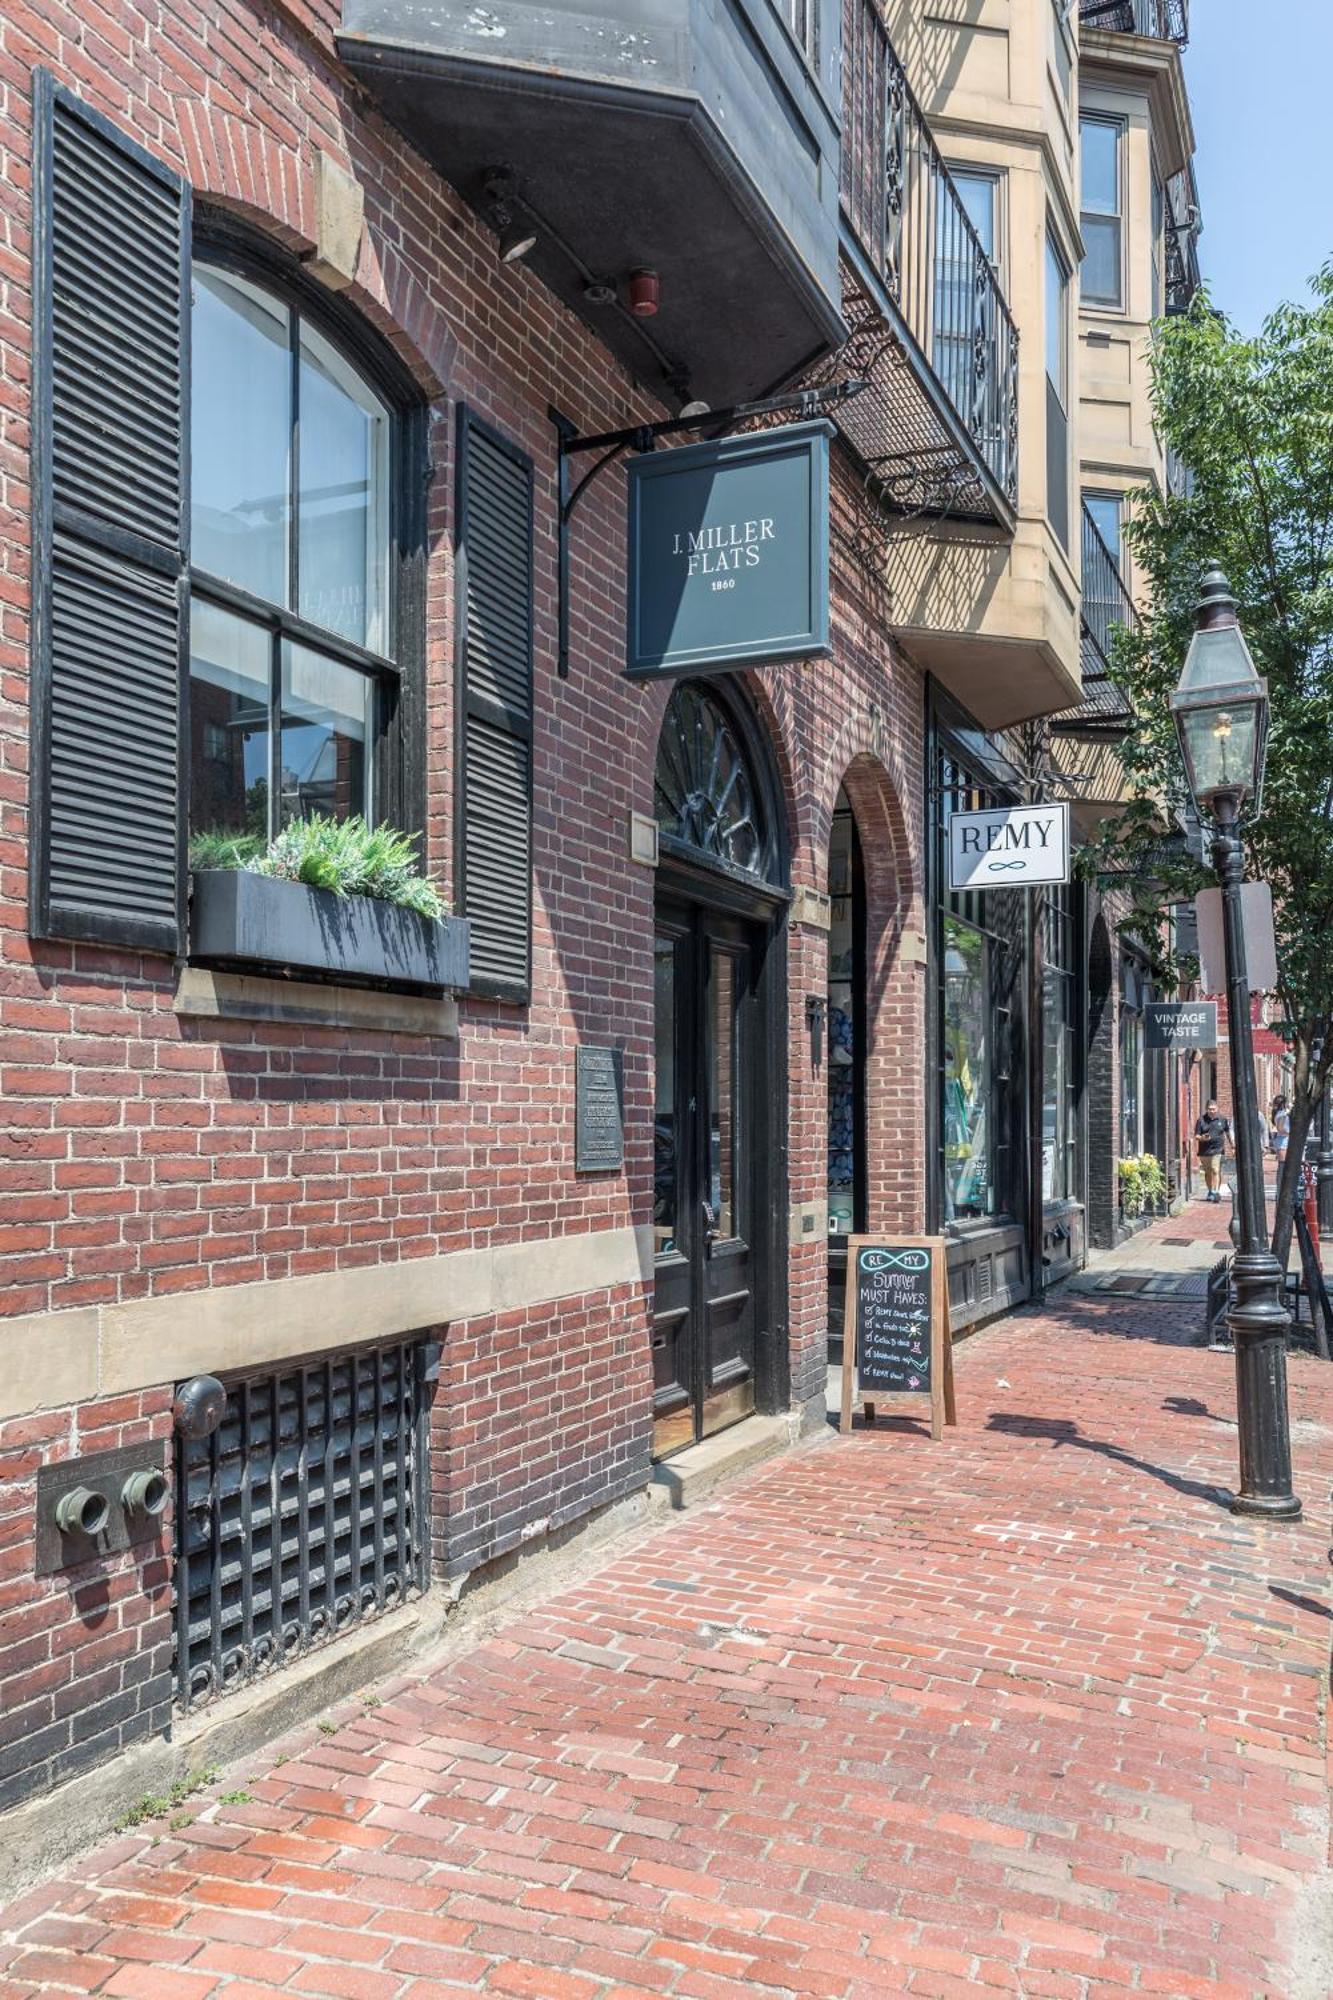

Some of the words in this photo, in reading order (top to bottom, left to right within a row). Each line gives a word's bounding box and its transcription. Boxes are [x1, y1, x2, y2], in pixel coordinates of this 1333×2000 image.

[672, 534, 683, 555] J.
[688, 518, 776, 553] MILLER
[687, 545, 760, 576] FLATS
[711, 579, 736, 591] 1860
[960, 819, 1055, 854] REMY
[1154, 1012, 1207, 1024] VINTAGE
[1162, 1026, 1200, 1037] TASTE
[873, 1271, 920, 1290] Summer
[860, 1288, 889, 1304] MUST
[894, 1290, 928, 1305] HAVES:
